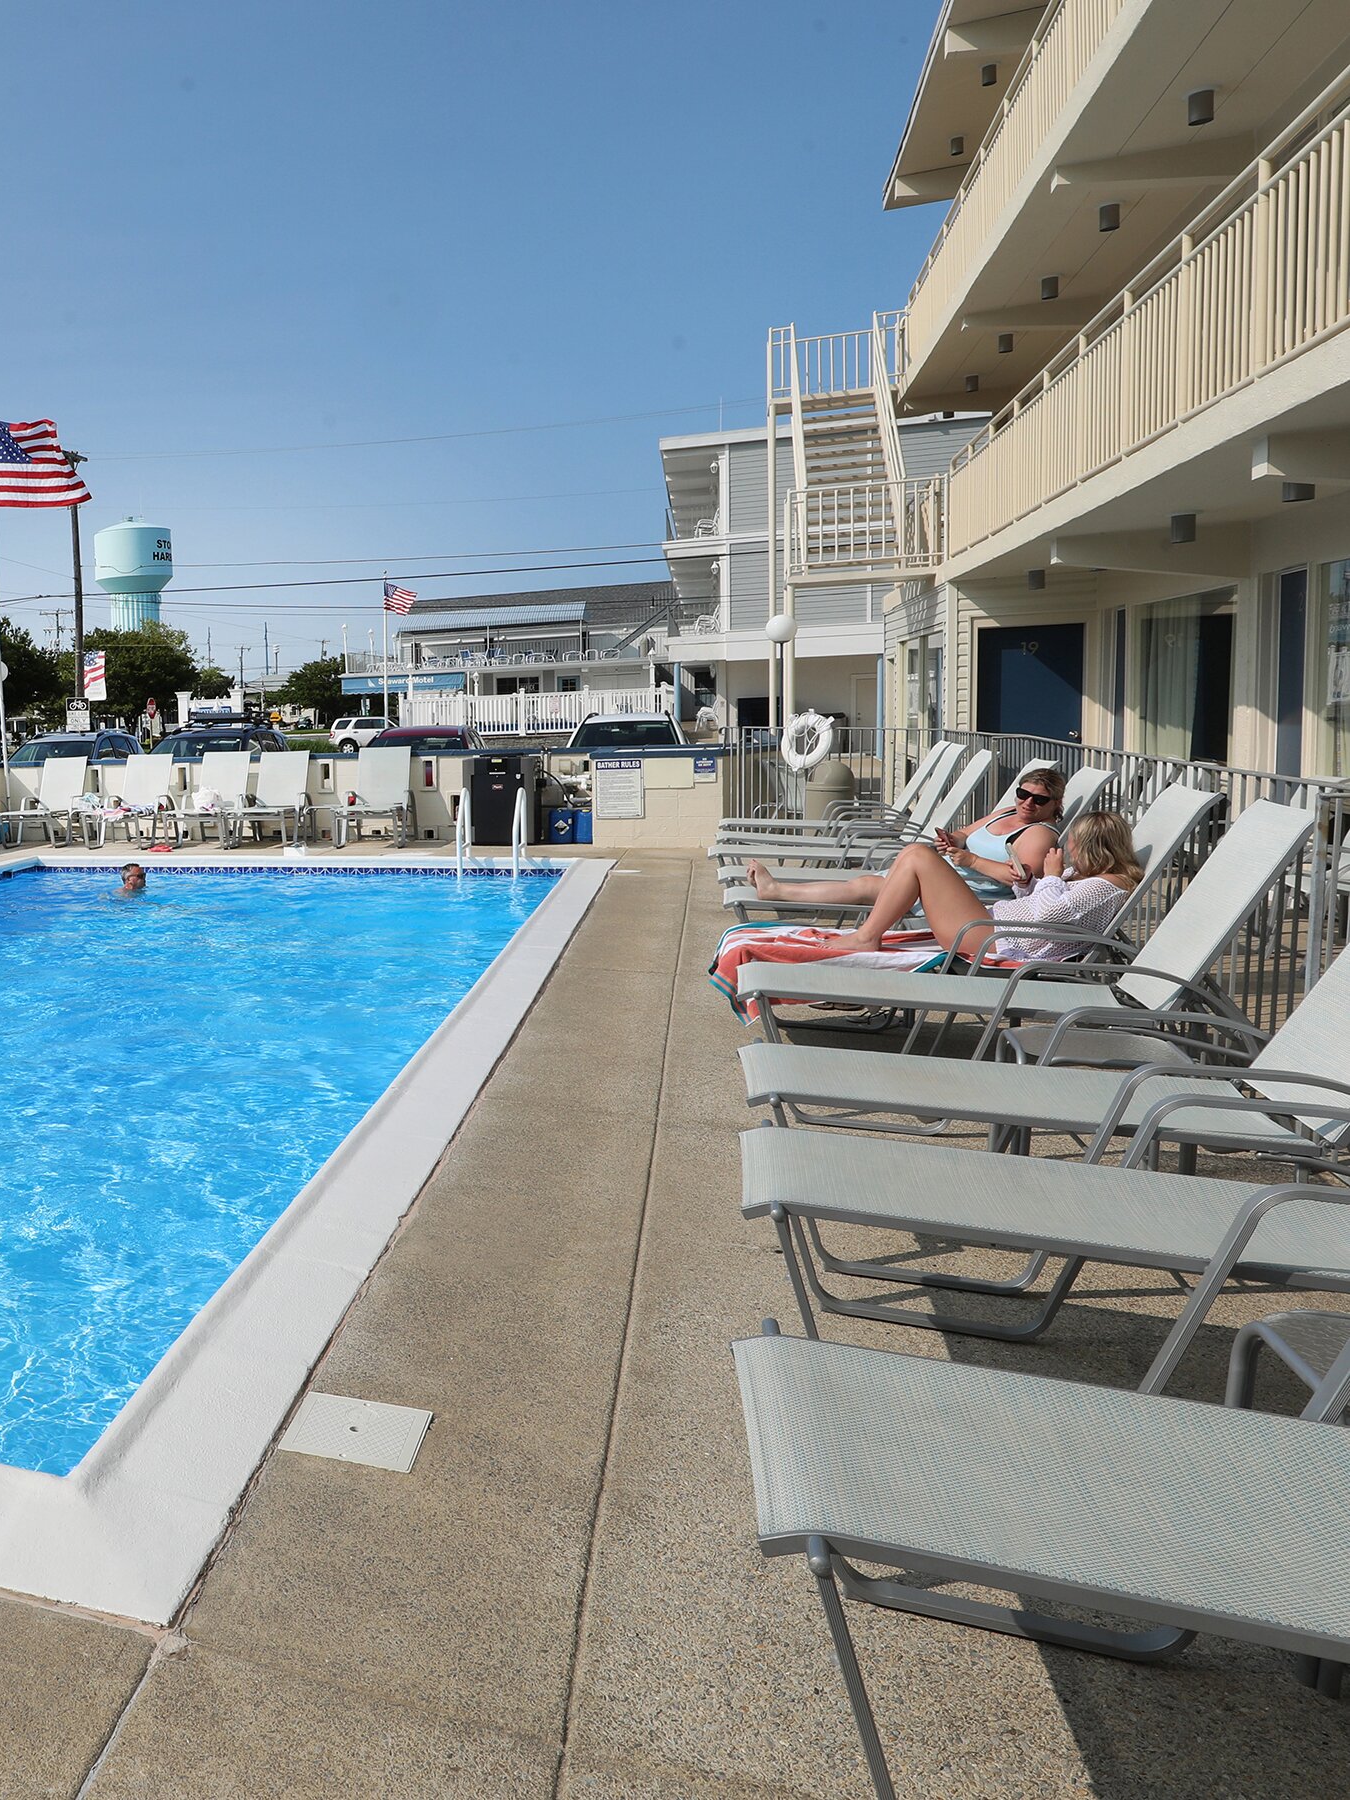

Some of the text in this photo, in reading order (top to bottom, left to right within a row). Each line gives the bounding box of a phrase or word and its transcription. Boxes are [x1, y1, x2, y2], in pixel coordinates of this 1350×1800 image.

[1020, 641, 1039, 656] 19
[596, 760, 640, 769] BATHER RULES
